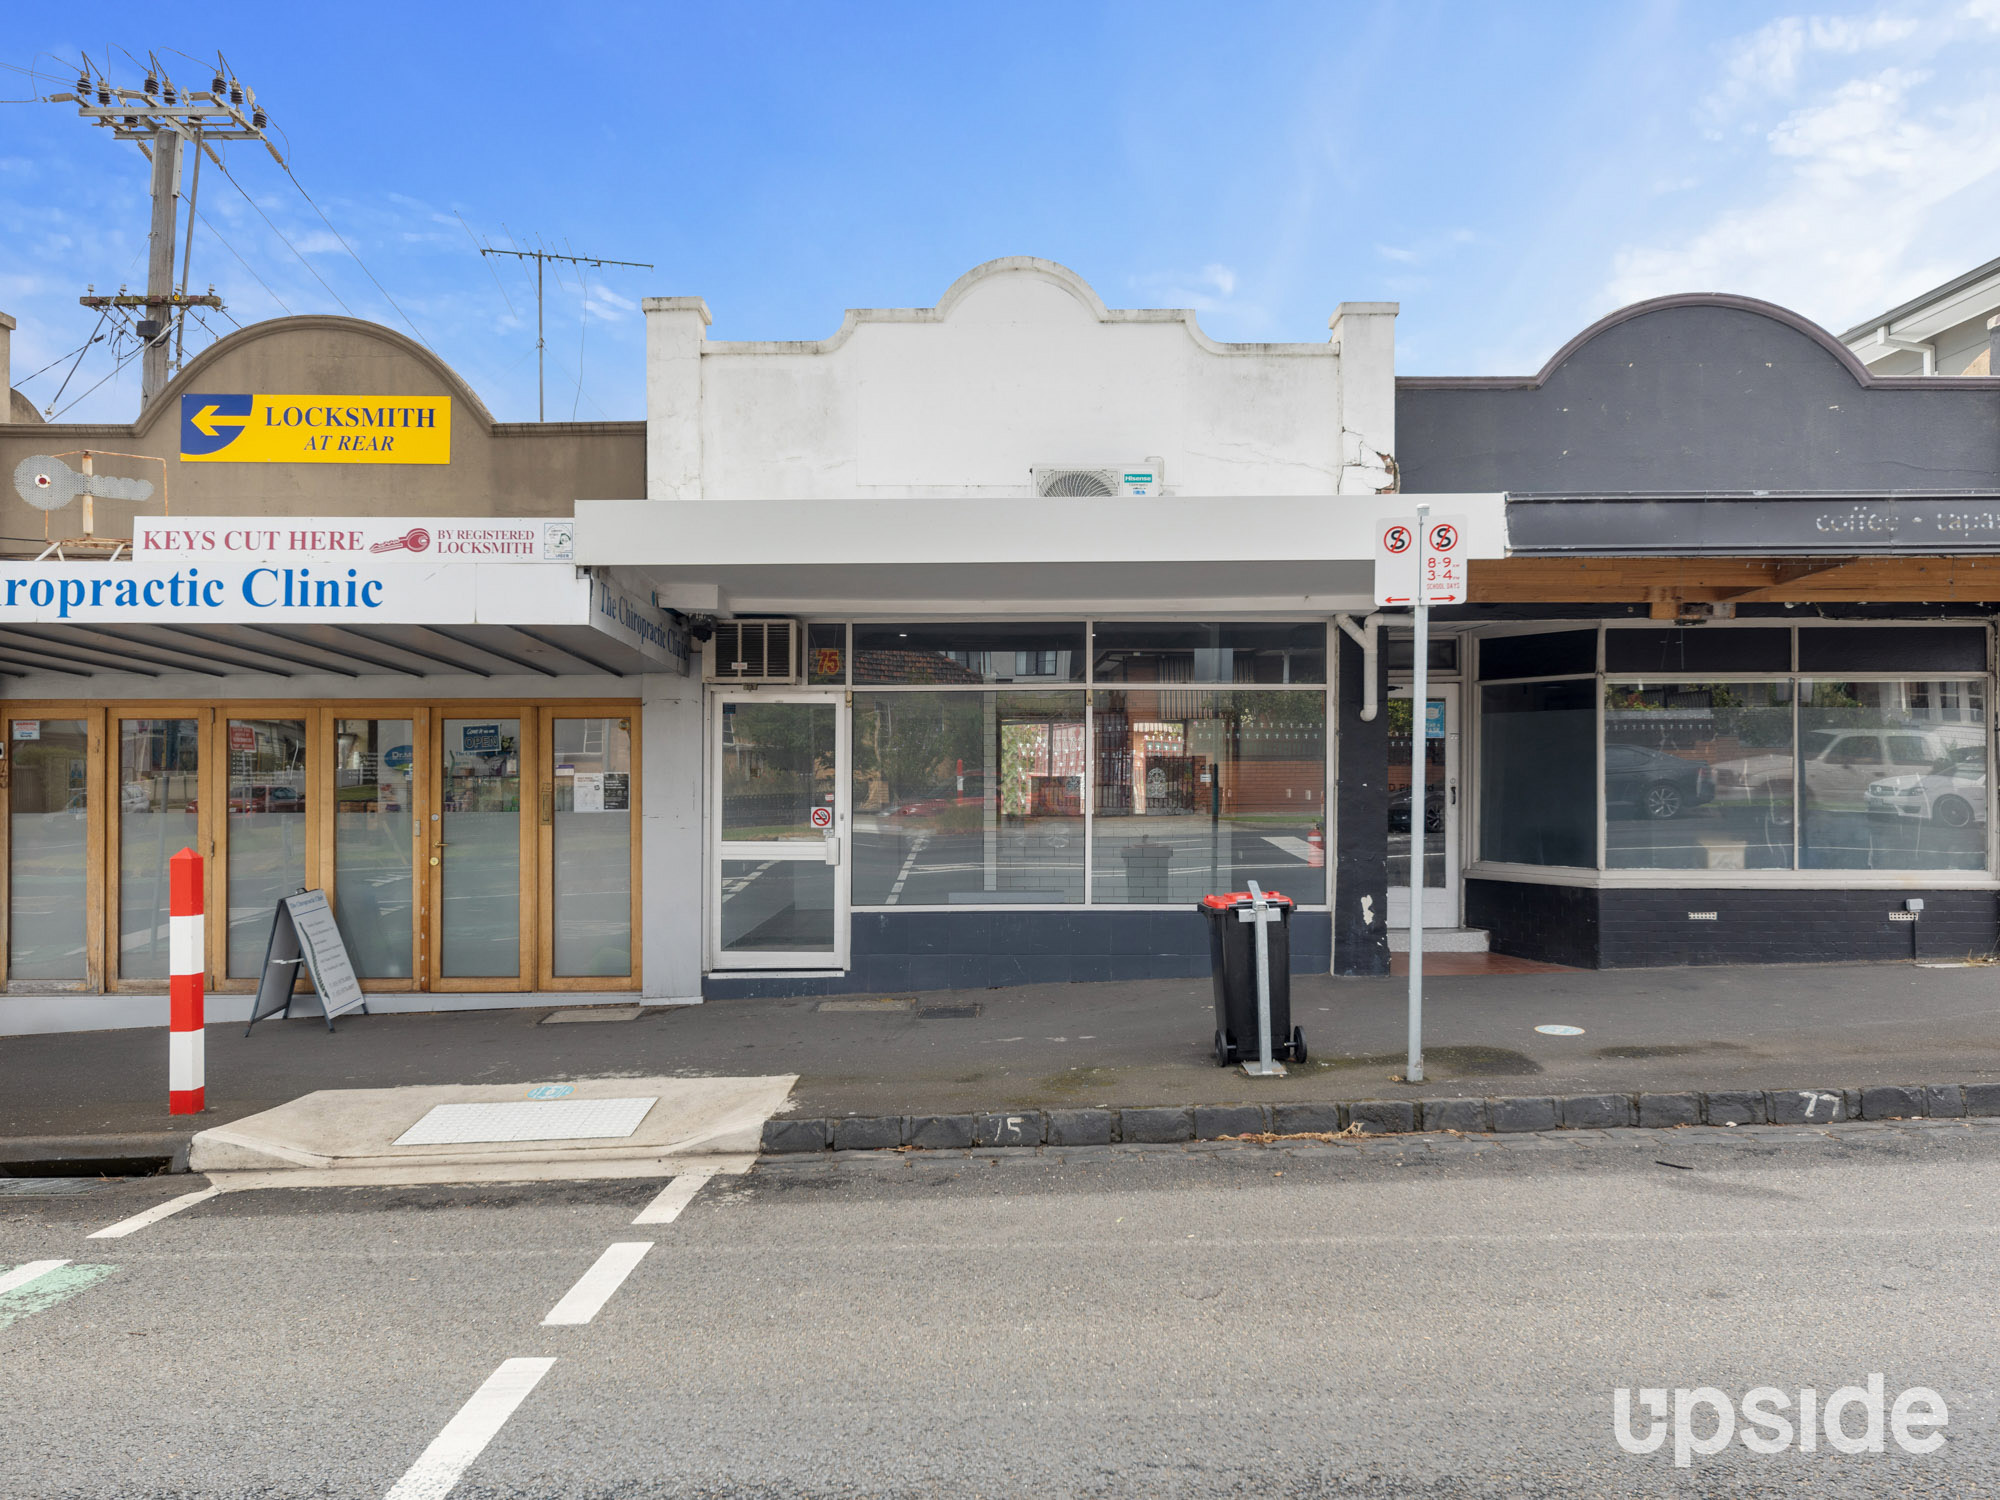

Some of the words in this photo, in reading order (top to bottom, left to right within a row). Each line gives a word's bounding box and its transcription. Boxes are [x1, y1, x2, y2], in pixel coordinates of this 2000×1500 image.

[265, 406, 436, 428] LOCKSMITH
[304, 435, 332, 451] AT
[337, 435, 395, 451] REAR
[437, 530, 455, 540] BY
[457, 530, 535, 540] REGISTERED
[1936, 512, 2000, 538] tapa
[143, 530, 216, 551] KEYS
[224, 530, 281, 551] CUT
[288, 530, 364, 551] HERE
[437, 541, 534, 554] LOCKSMITH
[1427, 557, 1452, 569] 8-9
[1427, 569, 1452, 581] 3-4
[0, 567, 225, 619] ropractic
[241, 567, 384, 609] Clinic
[600, 582, 617, 620] The
[618, 595, 667, 650] Chiropractic
[815, 648, 840, 676] 75
[465, 735, 498, 749] OPEN
[1798, 1091, 1841, 1118] 77
